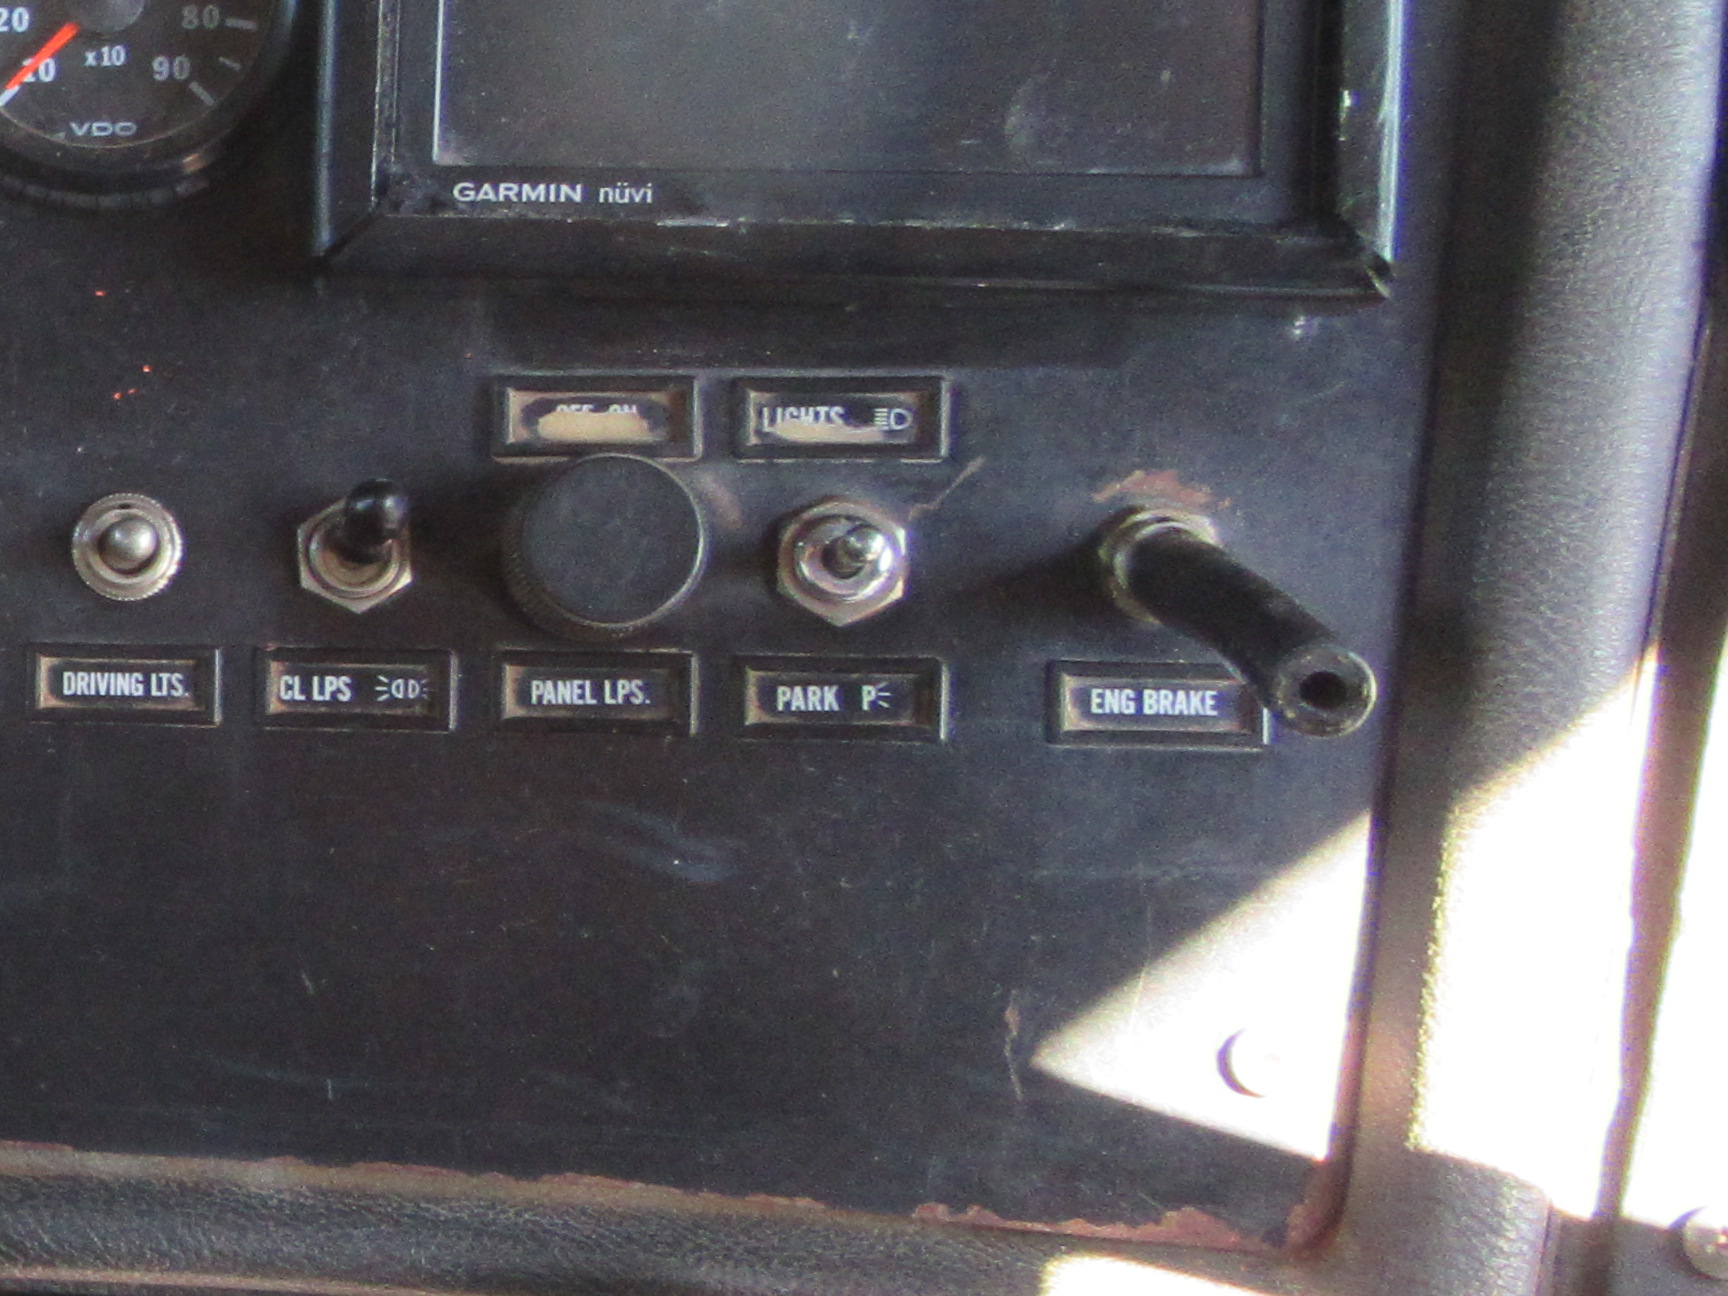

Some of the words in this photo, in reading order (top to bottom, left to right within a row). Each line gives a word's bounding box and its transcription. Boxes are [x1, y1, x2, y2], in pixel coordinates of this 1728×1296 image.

[181, 5, 220, 30] 80
[152, 56, 190, 81] 90
[70, 122, 137, 136] VDO
[452, 182, 583, 203] GARMIN
[599, 182, 653, 203] nüvi
[62, 671, 144, 696] DRIVING
[150, 672, 191, 697] LTS.
[279, 675, 306, 701] CL
[312, 676, 352, 702] LPS
[530, 679, 597, 705] PANEL
[604, 680, 651, 705] LPS.
[776, 685, 840, 711] PARK
[1091, 688, 1136, 714] ENG
[1143, 689, 1219, 716] BRAKE
